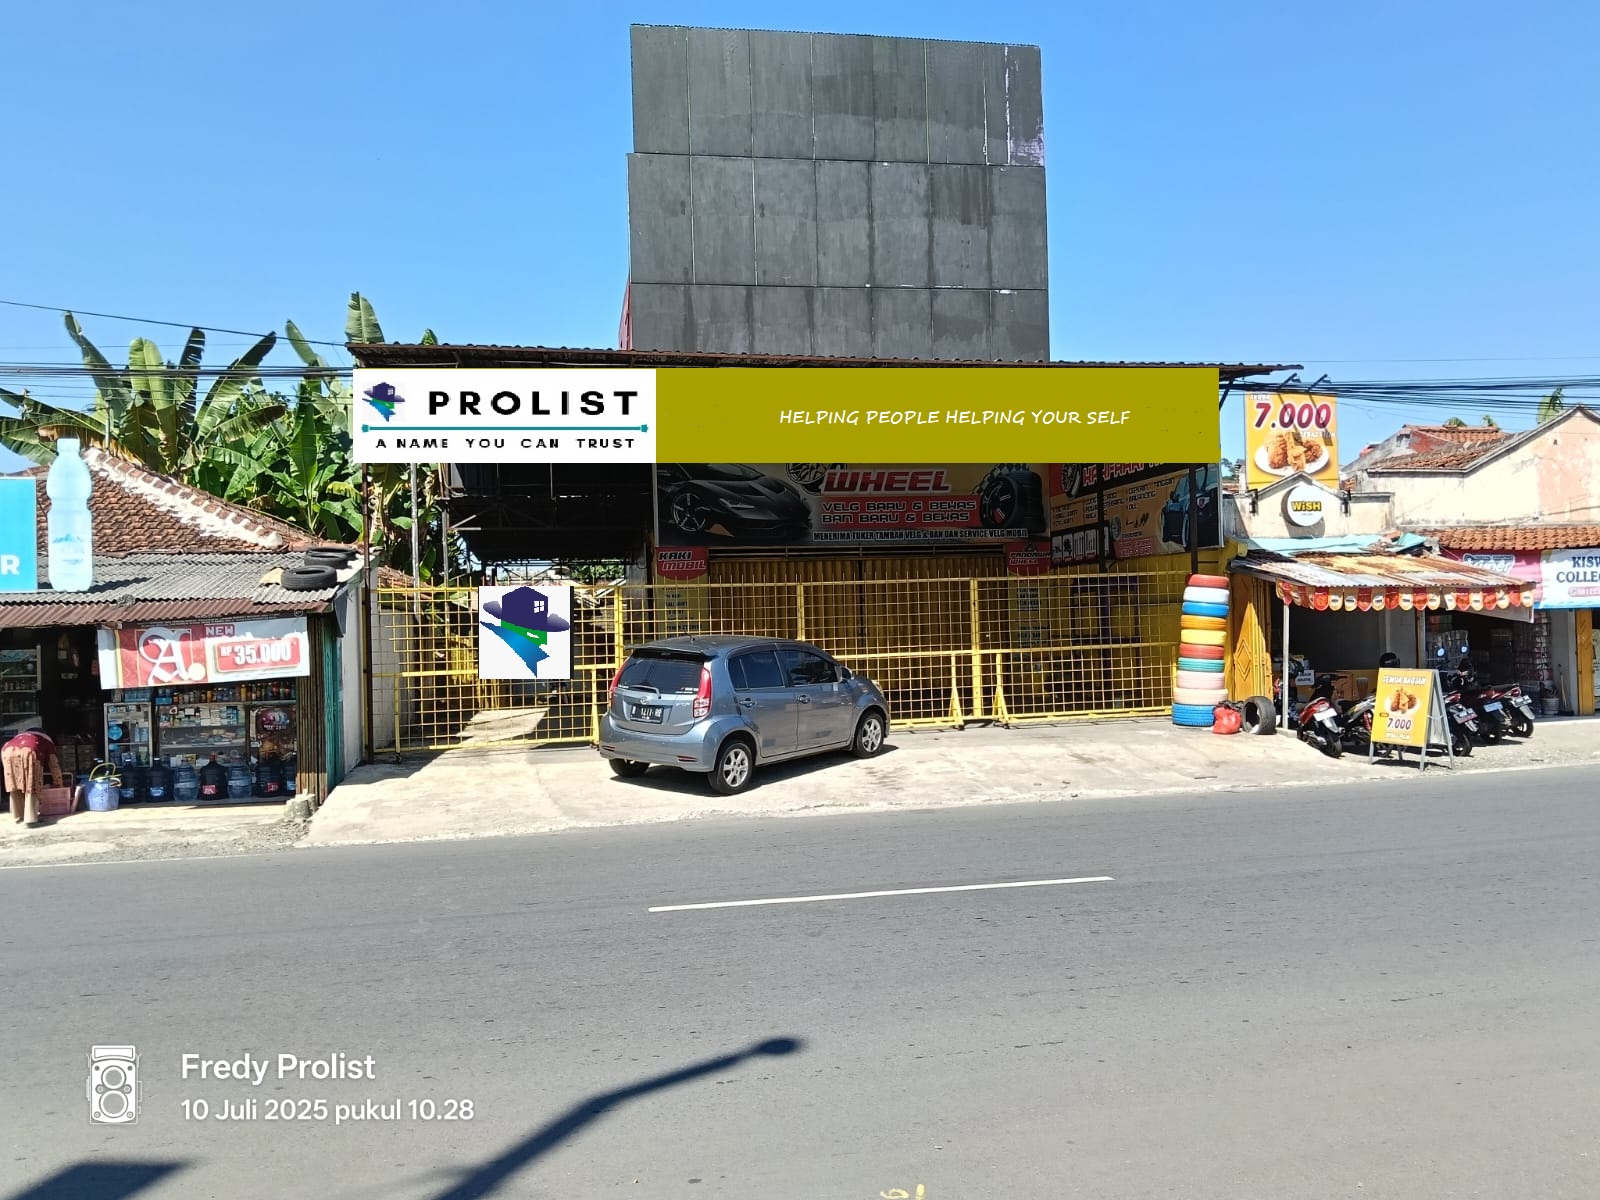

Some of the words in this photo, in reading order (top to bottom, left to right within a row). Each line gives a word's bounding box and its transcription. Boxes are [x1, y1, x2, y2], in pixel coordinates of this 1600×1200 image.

[1254, 401, 1333, 430] 7.000
[821, 469, 952, 494] WHEEL
[822, 501, 860, 512] VELG
[866, 501, 907, 512] BARU
[912, 501, 923, 512] &
[822, 512, 854, 523] BAN
[859, 512, 899, 523] BARU
[905, 512, 916, 523] &
[876, 531, 904, 540] TAMBAH
[959, 529, 987, 538] SERVICE
[657, 551, 693, 562] KAKI
[661, 560, 706, 571] MOBIL
[1556, 571, 1600, 583] COLLE
[206, 626, 234, 636] NEW
[234, 639, 292, 665] 35.000
[1387, 717, 1412, 731] 7.000
